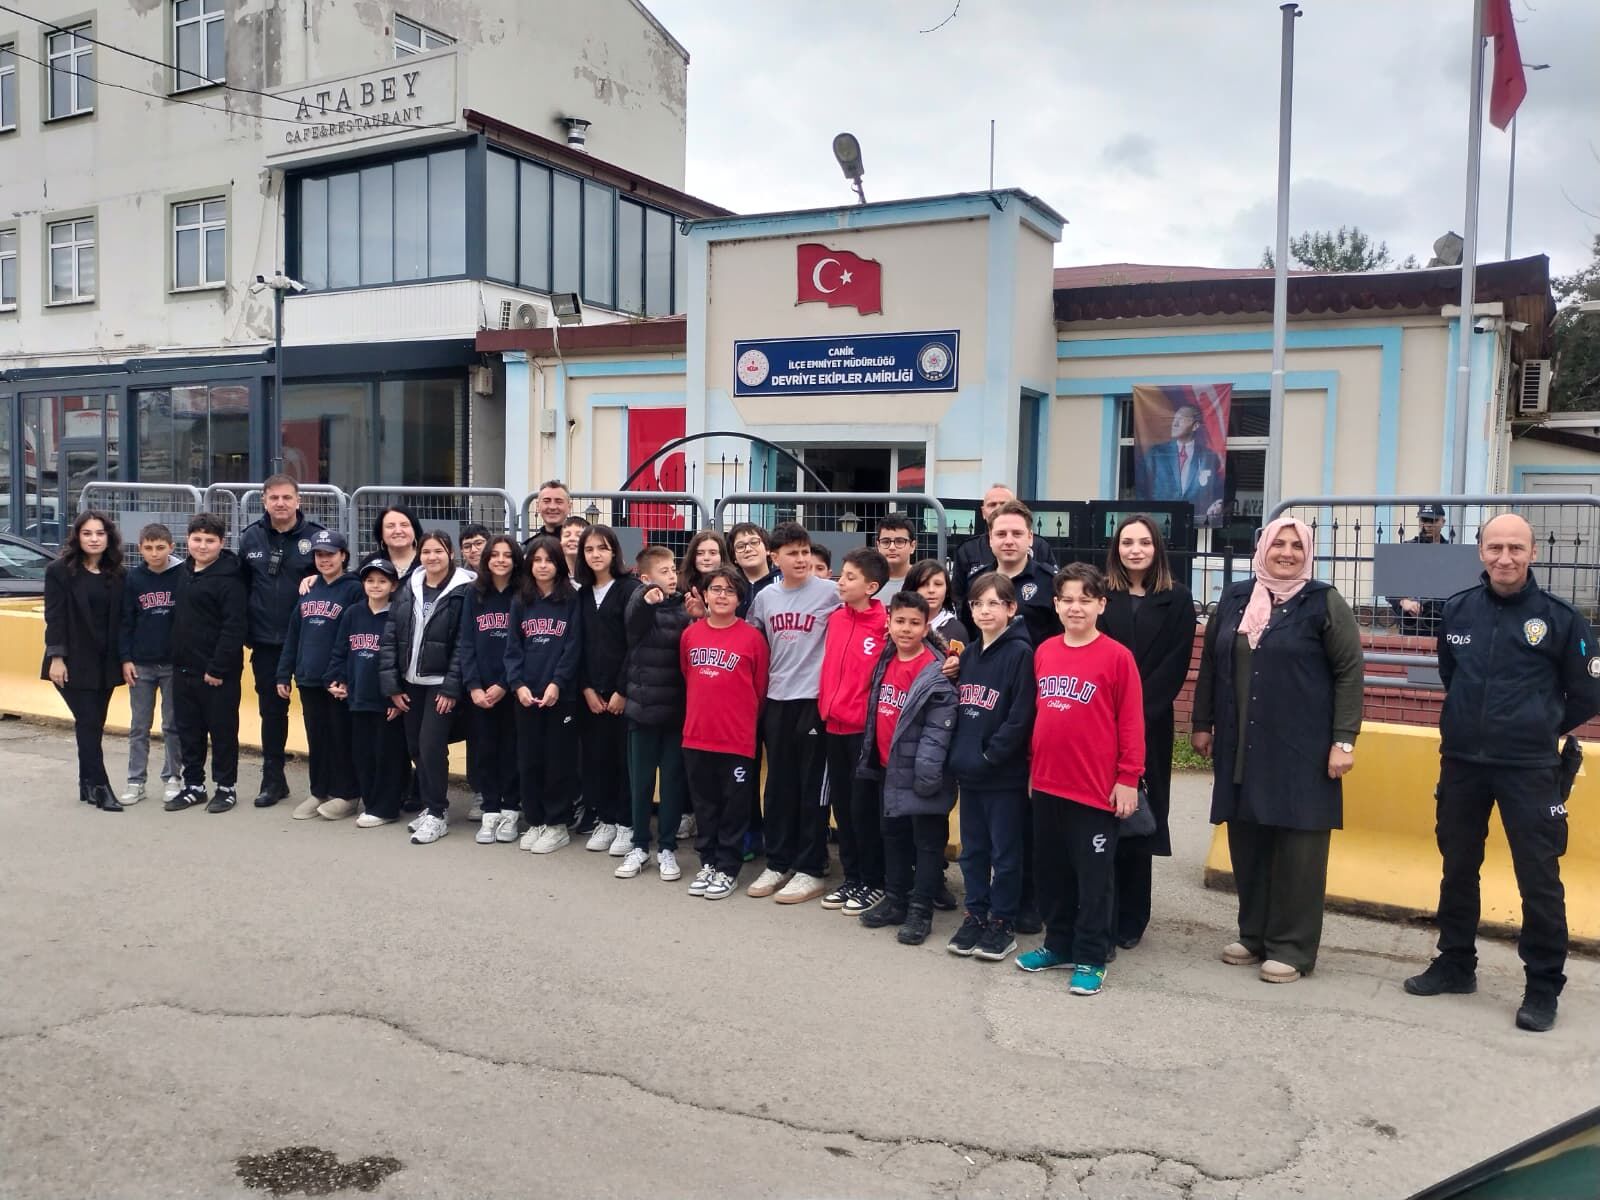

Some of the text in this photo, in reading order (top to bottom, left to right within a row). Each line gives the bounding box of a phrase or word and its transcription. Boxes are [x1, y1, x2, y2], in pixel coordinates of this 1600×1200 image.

[295, 71, 420, 120] ATABEY
[285, 106, 423, 144] CAFE&RESTAURANT
[828, 345, 855, 357] CANİK
[843, 355, 896, 368] MÜDÜRLÜĞÜ
[771, 368, 913, 387] DEVRİYE EKİPLER AMİRLİĞİ
[138, 591, 176, 610] ZORL
[301, 600, 343, 620] ZORLU
[476, 612, 510, 631] ZOR
[521, 618, 568, 638] ZORLU
[769, 611, 817, 634] ZORLU
[349, 633, 380, 652] ZORL
[690, 647, 741, 672] ZORLU
[1039, 674, 1097, 705] ZORLU
[1047, 699, 1072, 711] College
